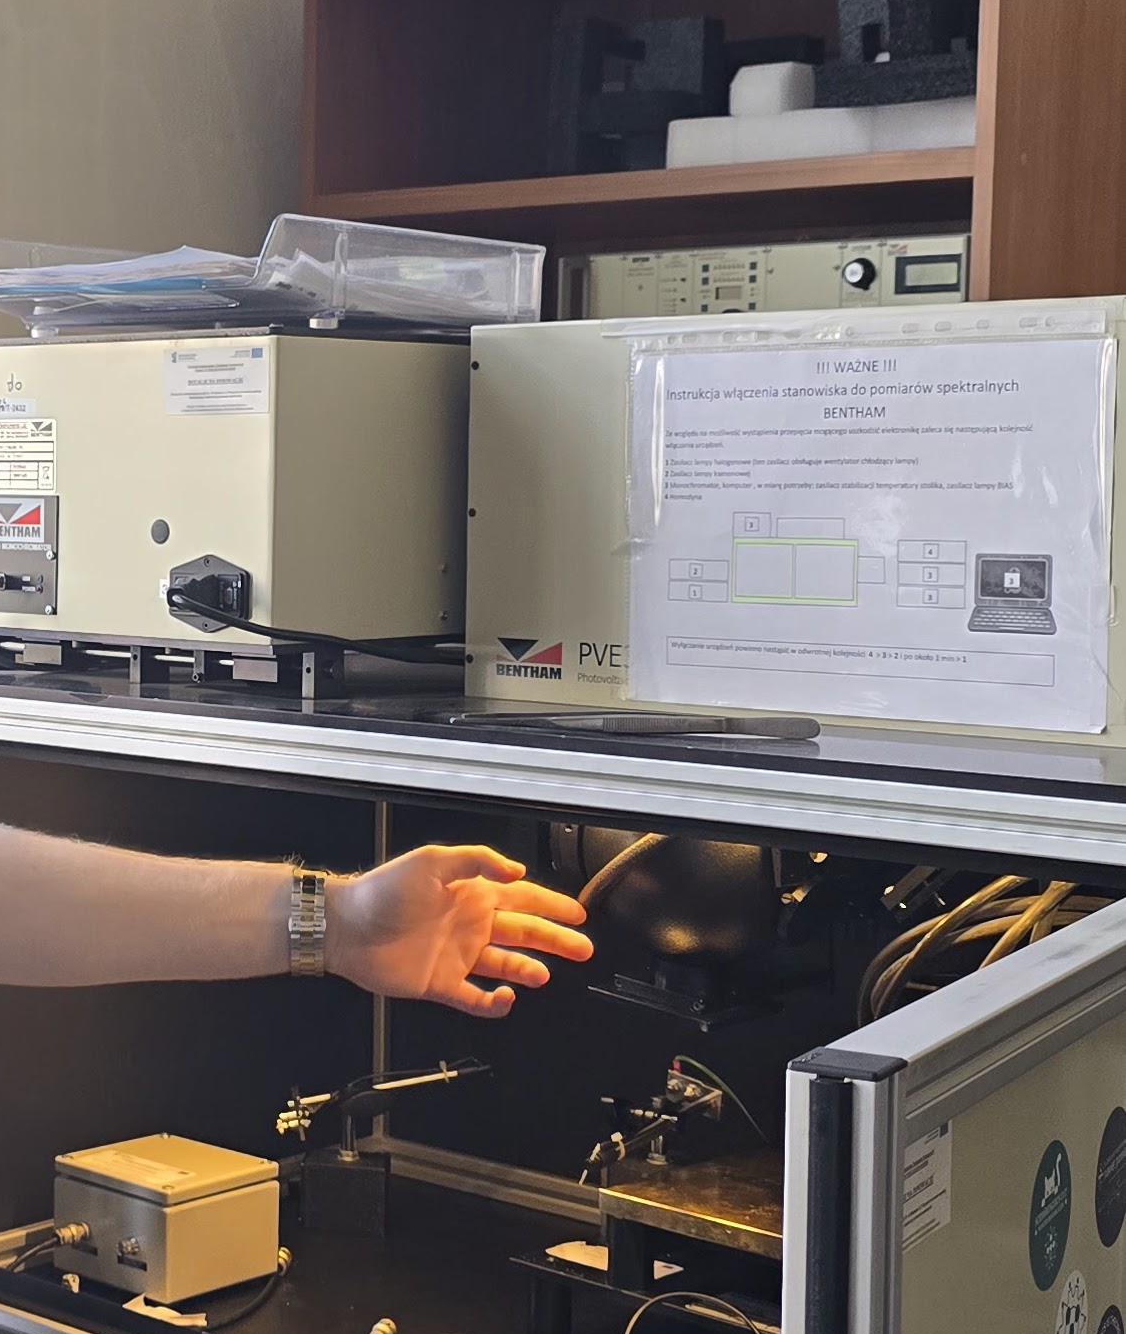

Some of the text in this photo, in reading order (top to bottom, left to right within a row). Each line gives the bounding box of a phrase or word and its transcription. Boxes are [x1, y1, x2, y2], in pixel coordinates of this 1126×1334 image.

[816, 358, 897, 374] !!! WAŻNE !!!
[666, 379, 1020, 402] Instrukcja włączenia stanowiska do pomiarów spektralnych
[823, 407, 886, 419] BENTHAM
[496, 664, 562, 680] BENTHAM
